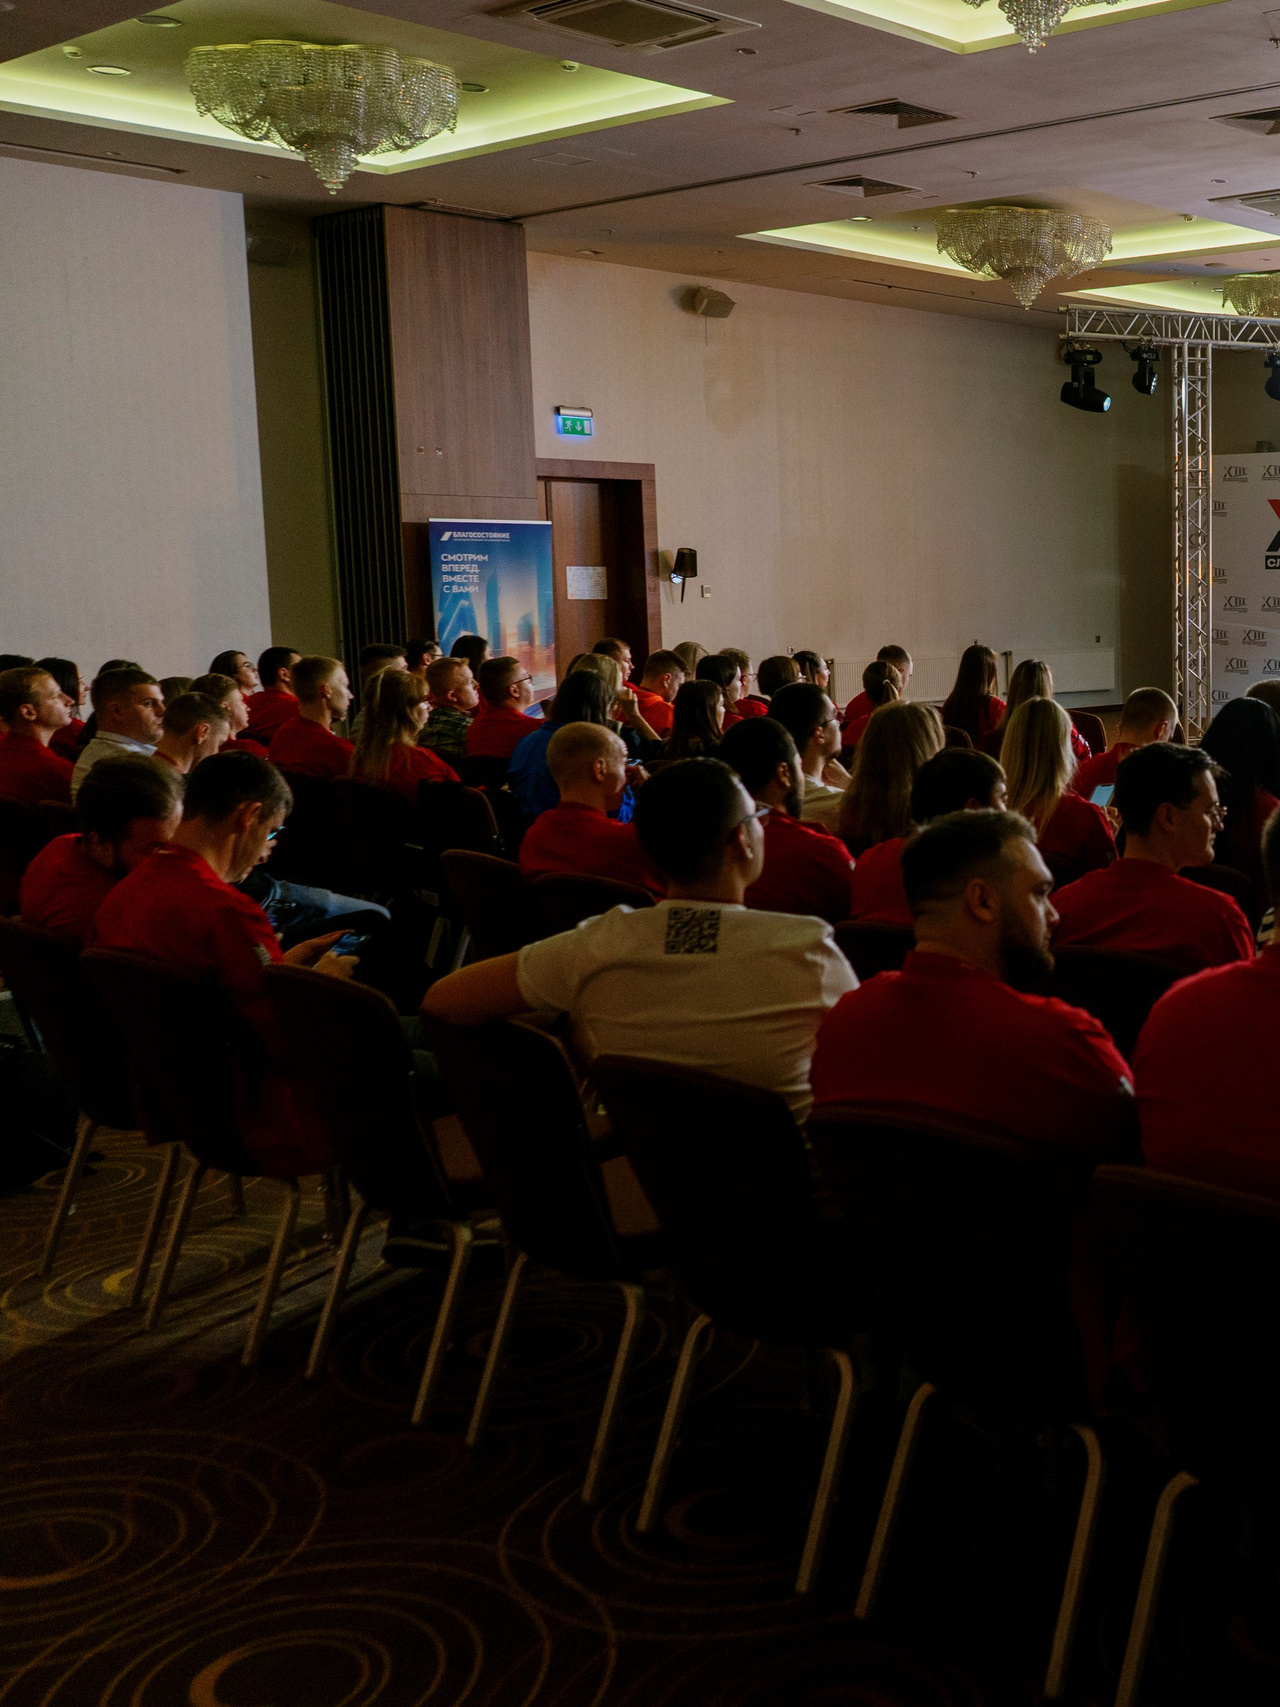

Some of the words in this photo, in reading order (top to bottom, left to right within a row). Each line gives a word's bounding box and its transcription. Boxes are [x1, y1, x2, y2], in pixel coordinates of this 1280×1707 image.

[442, 574, 480, 583] ВМЕСТЕ
[443, 585, 451, 593] С
[452, 585, 479, 593] ВАМИ
